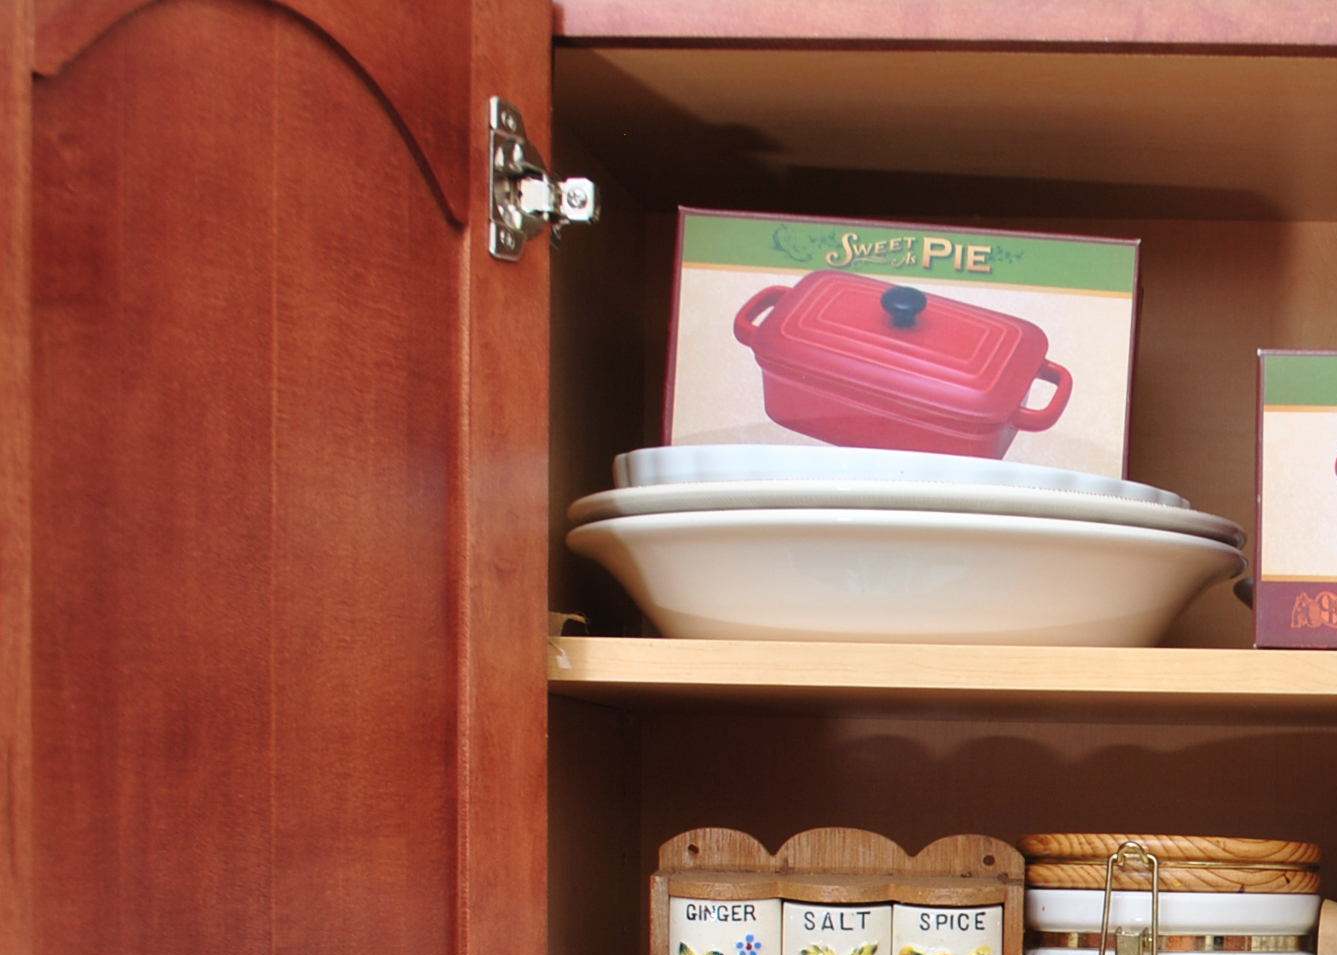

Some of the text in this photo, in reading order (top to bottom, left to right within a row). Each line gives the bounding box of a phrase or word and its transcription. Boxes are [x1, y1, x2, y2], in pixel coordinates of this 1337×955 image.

[922, 236, 992, 273] PIE
[686, 903, 757, 923] GINGER
[804, 911, 871, 932] SALT
[919, 912, 987, 932] SPICE
